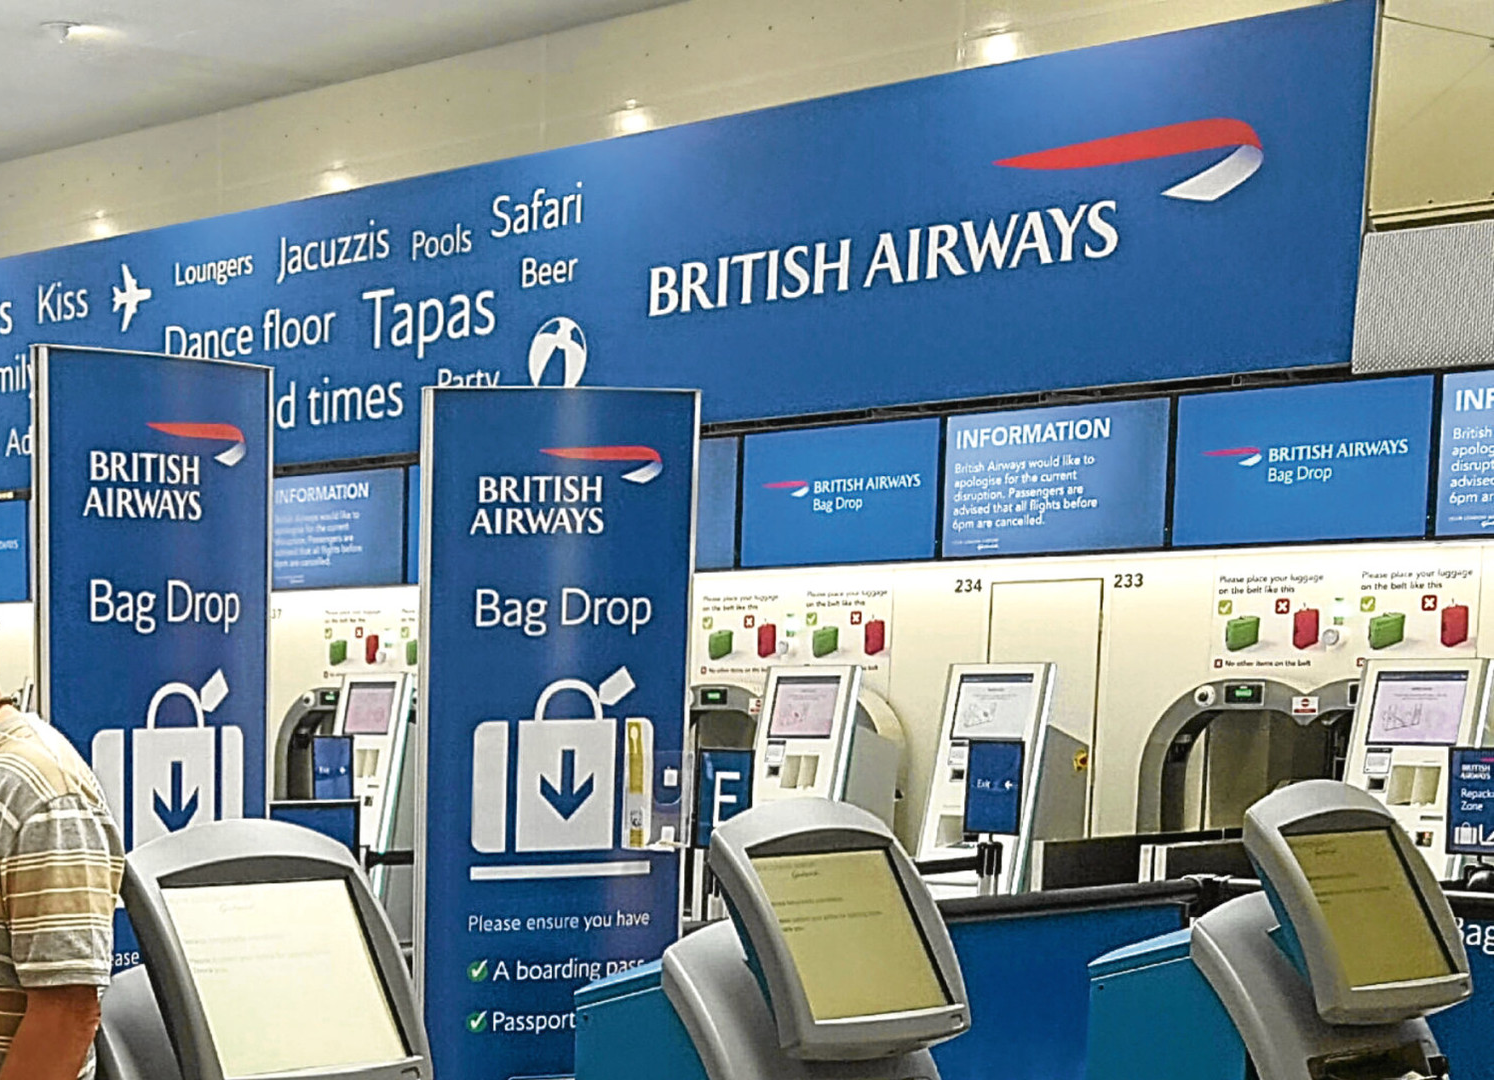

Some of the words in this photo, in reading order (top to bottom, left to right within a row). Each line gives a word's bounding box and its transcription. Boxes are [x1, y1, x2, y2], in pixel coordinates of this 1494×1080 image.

[491, 182, 582, 239] Safari
[277, 220, 390, 284] Jacuzzis
[412, 223, 471, 261] Pools
[175, 253, 253, 286] Loungers
[648, 238, 850, 318] BRITISH
[863, 200, 1119, 288] AIRWAYS
[522, 256, 577, 288] Beer
[37, 282, 89, 324] Kiss
[164, 323, 253, 358] Dance
[264, 308, 335, 351] floor
[363, 288, 495, 358] Tapas
[308, 377, 403, 425] times
[956, 417, 1111, 450] INFORMATION
[1453, 426, 1492, 440] British
[1268, 444, 1333, 462] BRITISH
[1336, 439, 1408, 459] AIRWAYS
[89, 450, 200, 485] BRITISH
[955, 462, 984, 474] British
[987, 459, 1025, 473] Airways
[1028, 456, 1059, 468] would
[1062, 454, 1081, 466] like
[1084, 454, 1095, 465] to
[1268, 467, 1293, 484] Bag
[1296, 466, 1332, 482] Drop
[478, 475, 603, 503] BRITISH
[813, 477, 863, 494] BRITISH
[866, 473, 921, 490] AIRWAYS
[954, 476, 1002, 490] apologise
[1005, 474, 1019, 485] for
[1021, 473, 1038, 483] the
[1040, 470, 1077, 482] current
[83, 487, 202, 520] AIRWAYS
[275, 482, 369, 504] INFORMATION
[1008, 486, 1064, 501] Passengers
[1067, 485, 1084, 495] are
[1449, 492, 1478, 505] 6pm
[813, 499, 833, 513] Bag
[836, 497, 863, 511] Drop
[953, 503, 990, 516] advised
[993, 502, 1013, 513] that
[1015, 500, 1027, 512] all
[1030, 499, 1061, 514] flights
[1063, 497, 1098, 509] before
[469, 507, 604, 535] AIRWAYS
[952, 519, 974, 532] 6pm
[977, 518, 993, 527] are
[995, 514, 1045, 527] cancelled.
[955, 578, 982, 593] 234
[1113, 573, 1144, 589] 233
[89, 579, 156, 634] Bag
[167, 579, 240, 633] Drop
[475, 588, 548, 636] Bag
[561, 587, 652, 634] Drop
[1460, 800, 1483, 811] Zone
[468, 914, 521, 932] Please
[526, 915, 579, 930] ensure
[583, 914, 611, 931] you
[616, 909, 650, 926] have
[112, 951, 140, 967] ase
[493, 961, 510, 981] A
[516, 958, 601, 982] boarding
[492, 1011, 576, 1034] Passport
